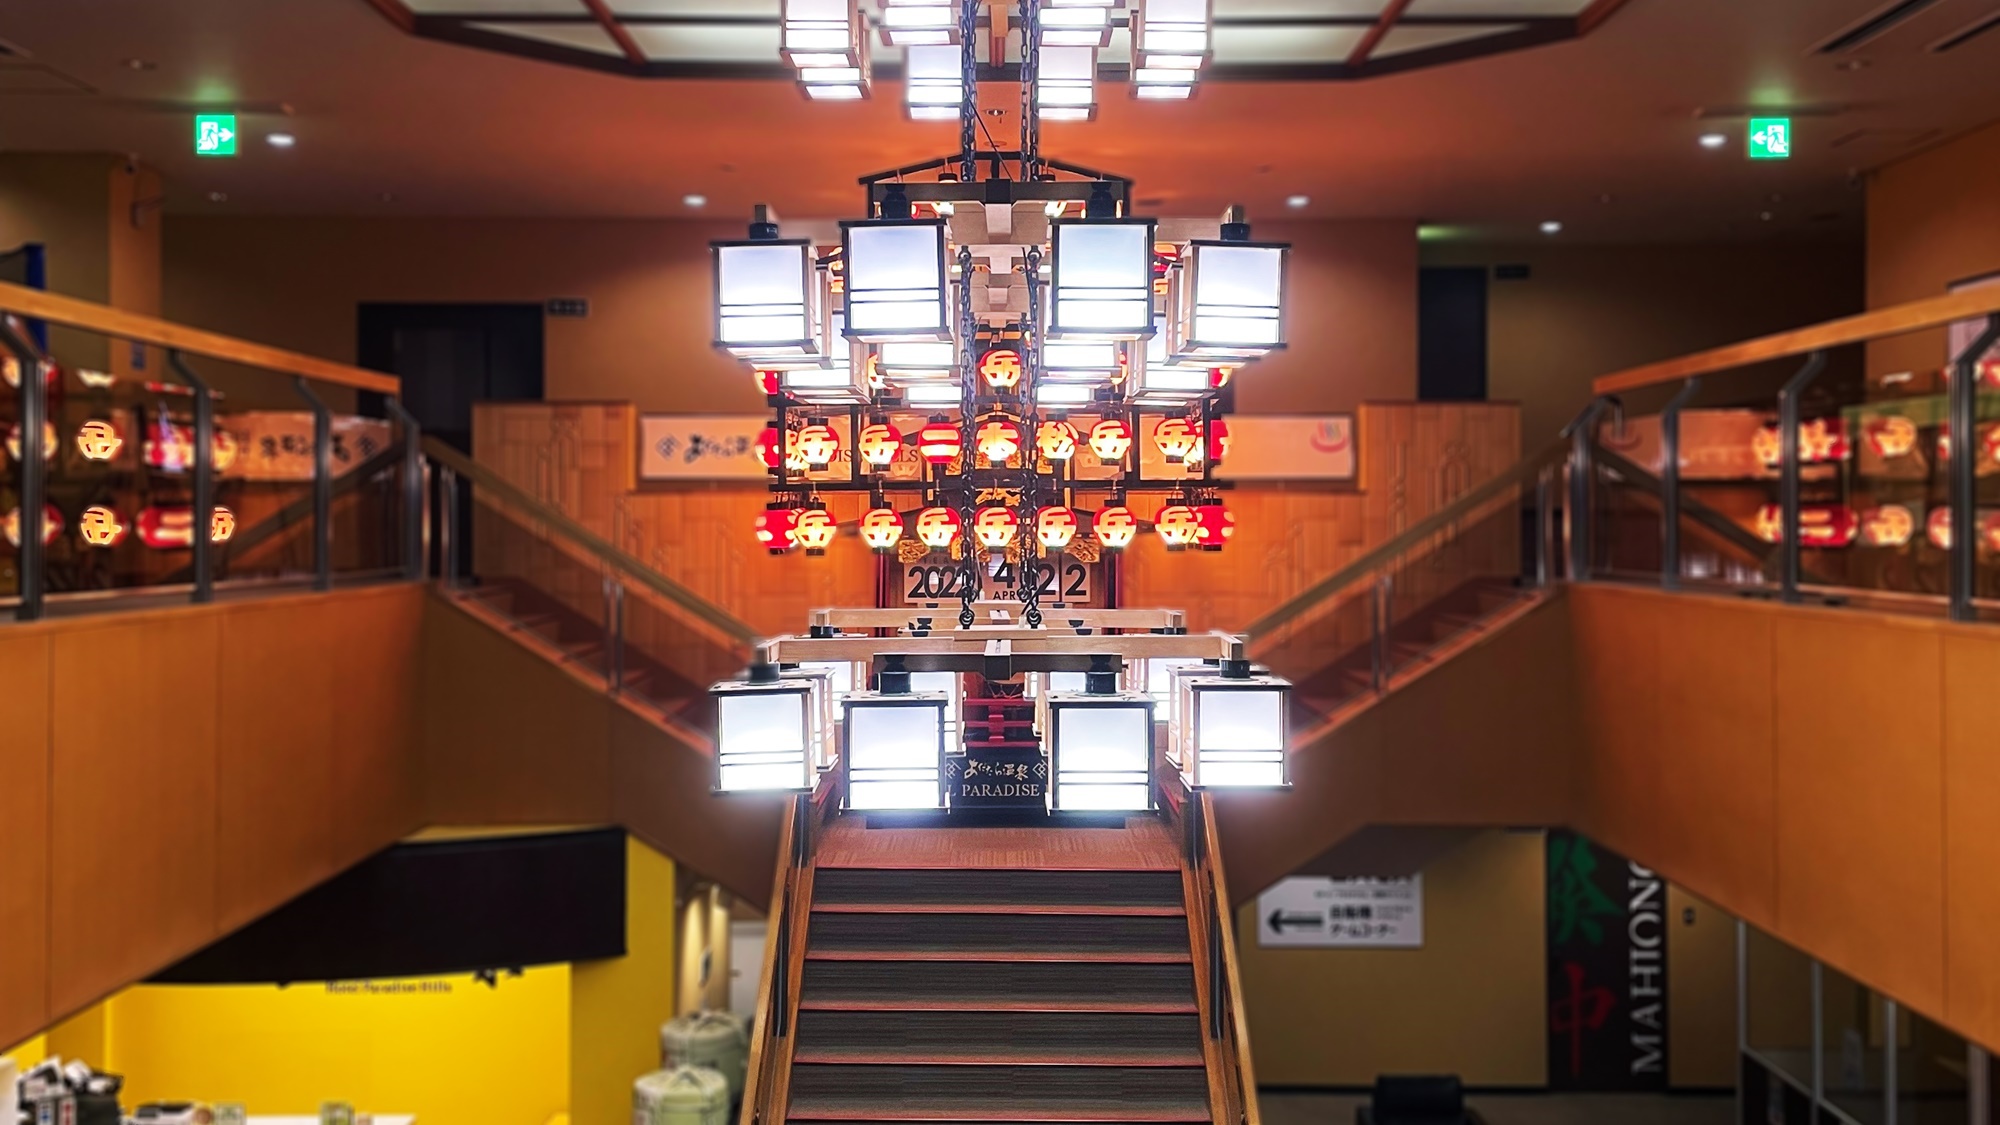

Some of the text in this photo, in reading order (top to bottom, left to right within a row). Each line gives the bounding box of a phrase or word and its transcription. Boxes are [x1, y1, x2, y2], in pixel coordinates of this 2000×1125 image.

[993, 559, 1016, 588] 4
[993, 590, 1016, 600] APR
[962, 784, 1040, 797] PARADISE
